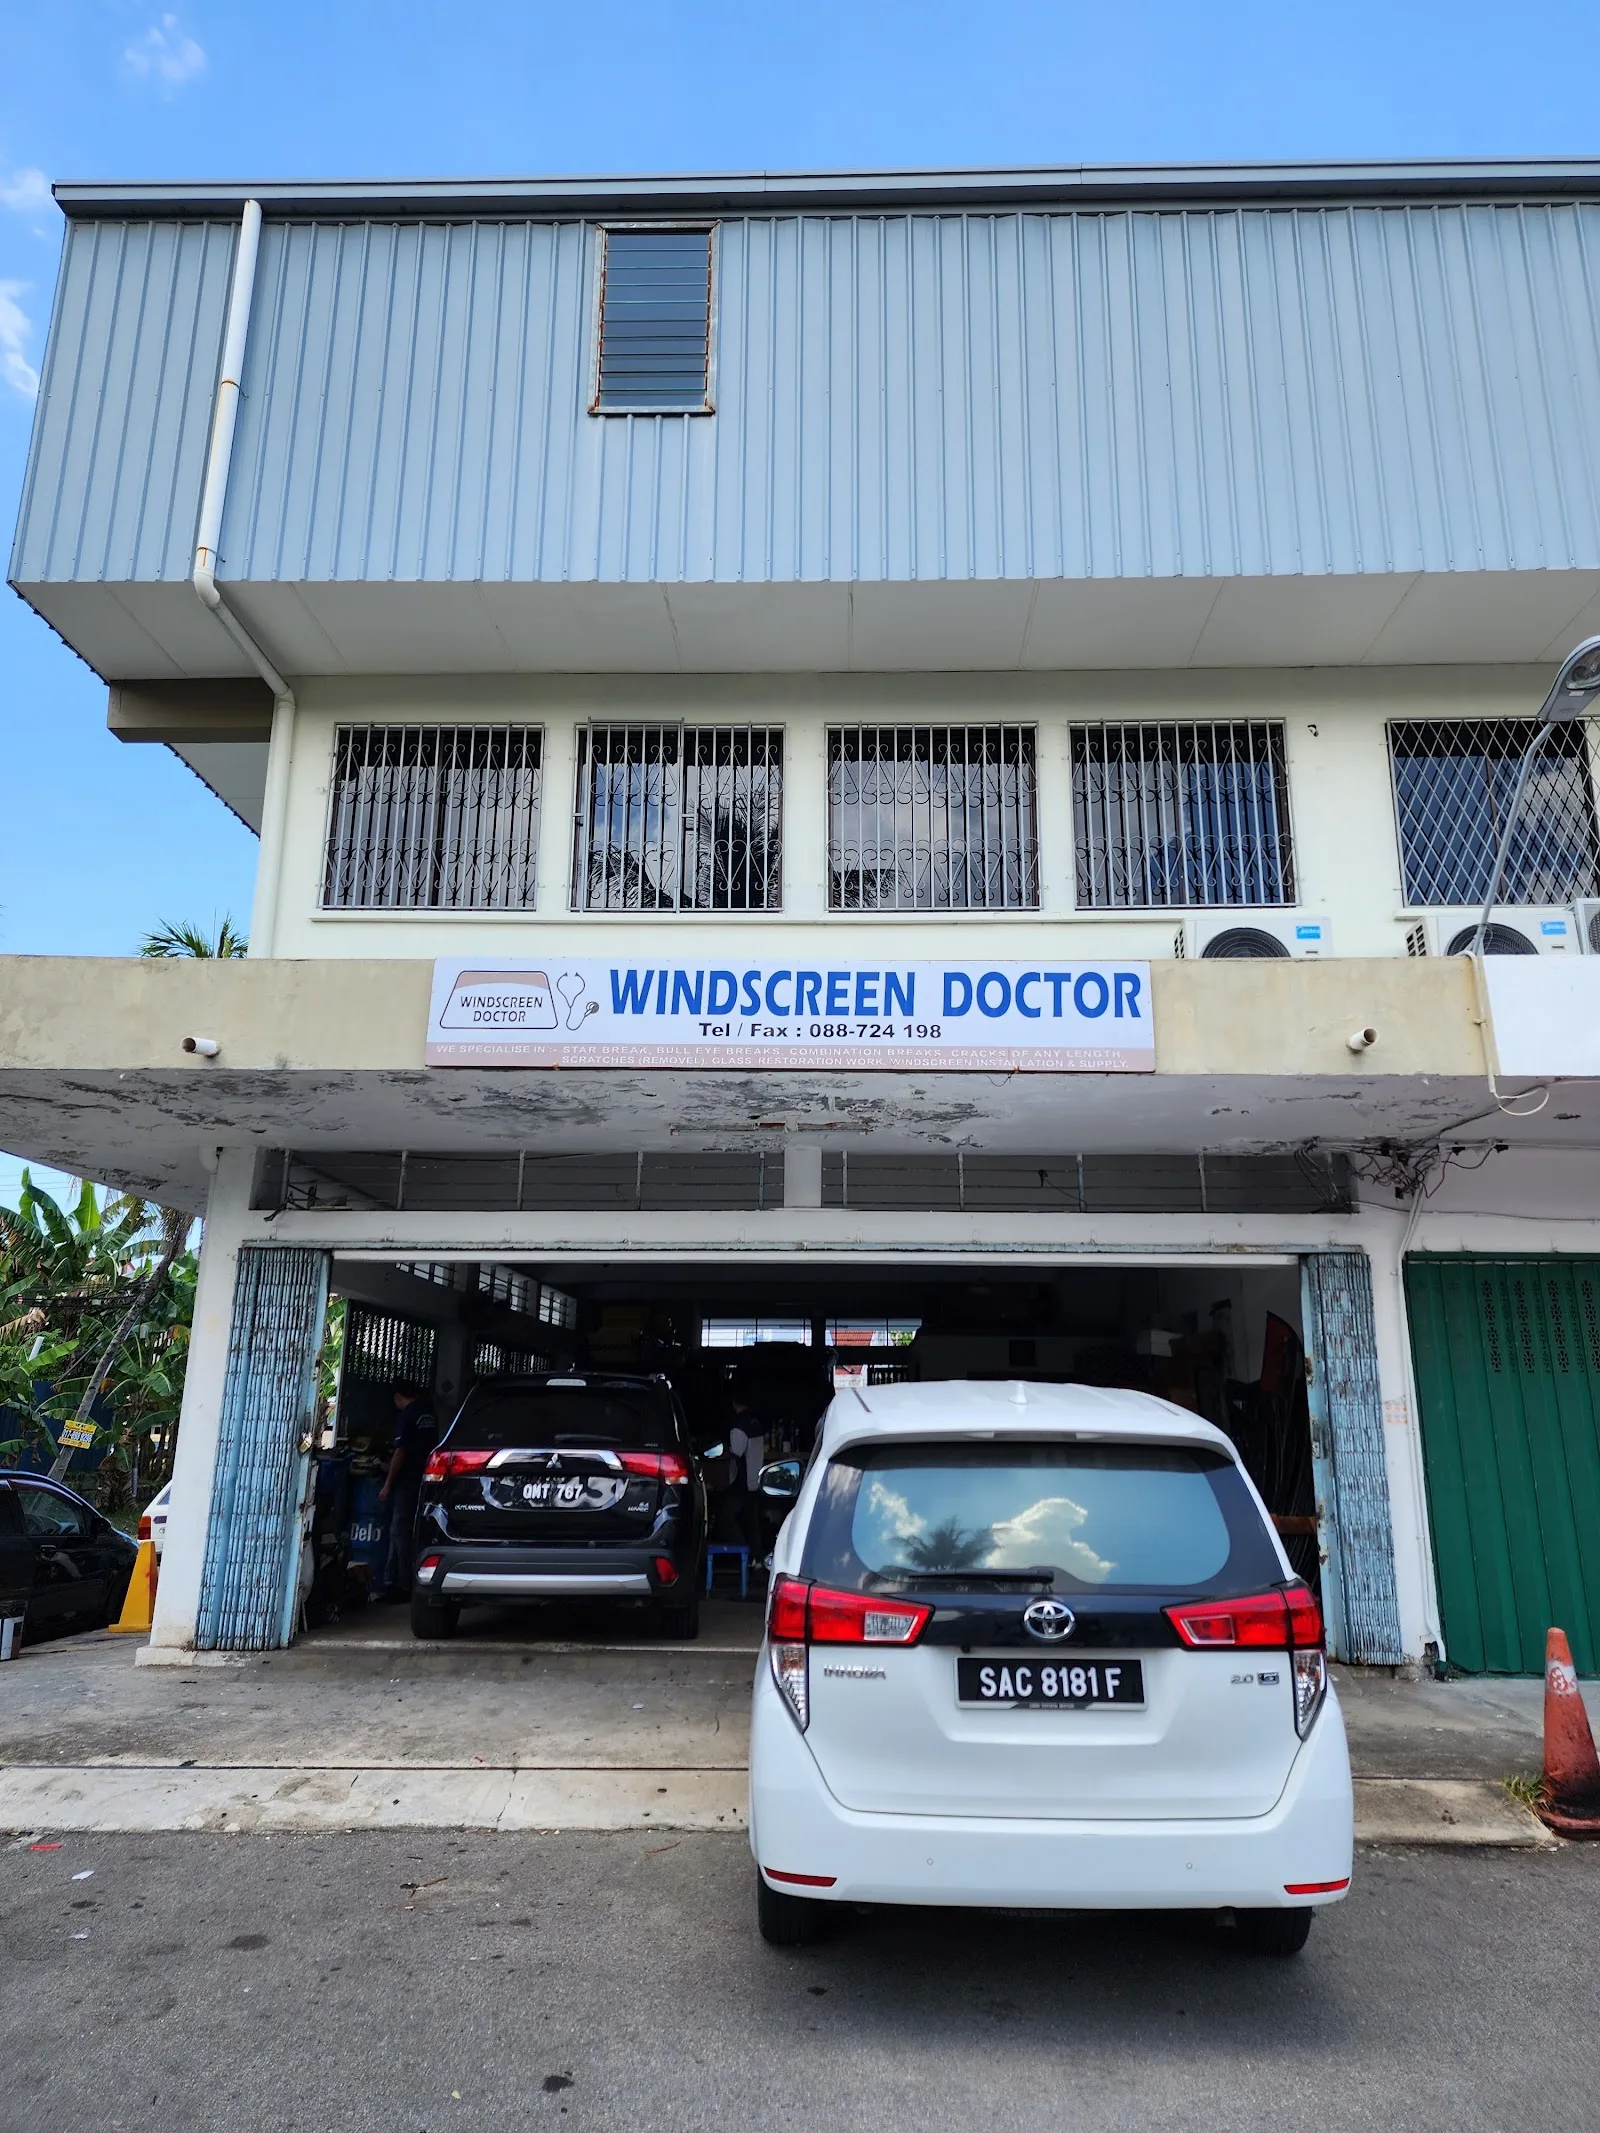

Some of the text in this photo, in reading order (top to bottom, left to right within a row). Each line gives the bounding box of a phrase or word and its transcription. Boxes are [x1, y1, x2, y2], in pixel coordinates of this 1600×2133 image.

[610, 969, 1142, 1018] WINDSCREEN DOCTOR
[460, 996, 544, 1008] WINDSCREEN
[473, 1010, 526, 1022] DOCTOR
[699, 1022, 730, 1037] Tel
[750, 1023, 788, 1037] Fax
[809, 1024, 895, 1038] 088-724
[903, 1024, 942, 1038] 198
[437, 1045, 456, 1053] WE
[459, 1045, 530, 1053] SPECIALISE
[534, 1045, 545, 1053] IN
[563, 1046, 596, 1054] STAR
[657, 1047, 691, 1055] BULL
[790, 1048, 881, 1056] COMBINATION
[951, 1050, 1005, 1058] CRACKS
[1012, 1050, 1028, 1058] OF
[1034, 1050, 1060, 1058] ANY
[562, 1056, 635, 1064] SCRATCHES
[712, 1057, 752, 1065] GLASS
[758, 1057, 844, 1066] RESTORATION
[891, 1059, 972, 1067] WINDSCREEN
[976, 1059, 1063, 1068] INSTALLATION
[1068, 1060, 1076, 1068] &
[523, 1483, 583, 1500] QMT 767
[350, 1522, 381, 1541] Delo
[823, 1664, 886, 1680] INNOVA
[979, 1666, 1122, 1699] SAC 8181 F
